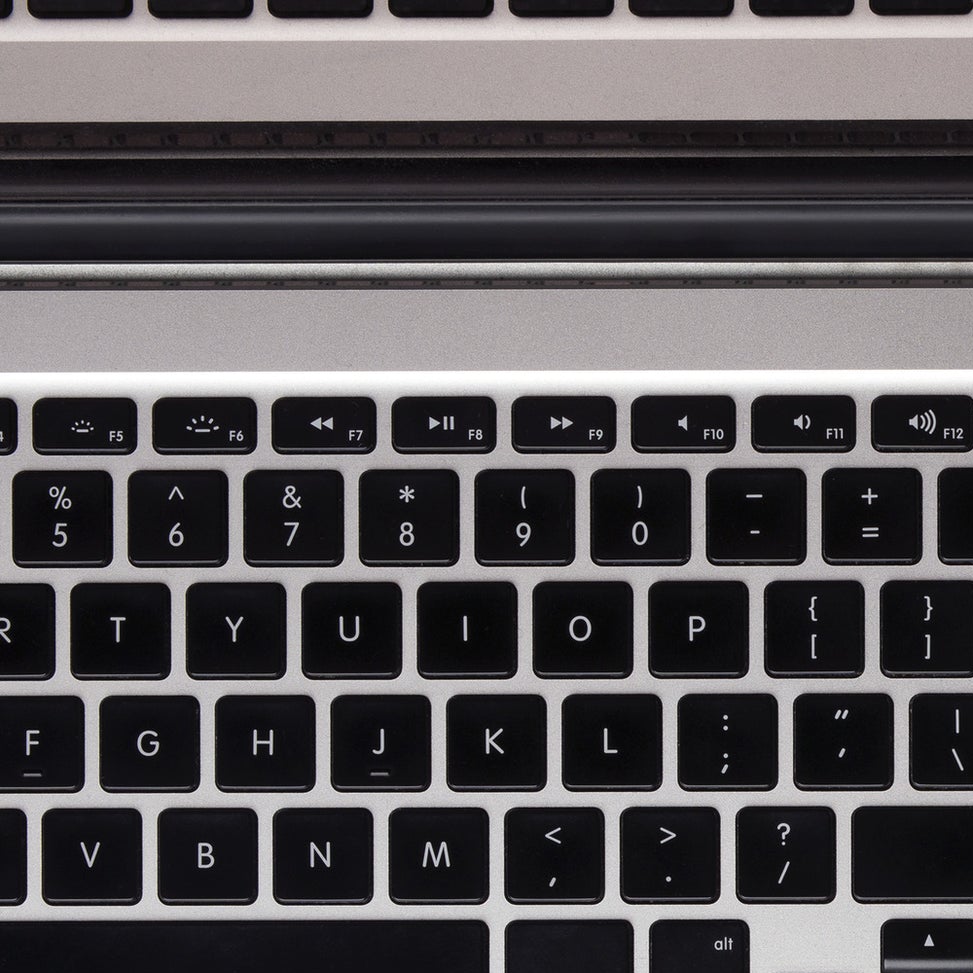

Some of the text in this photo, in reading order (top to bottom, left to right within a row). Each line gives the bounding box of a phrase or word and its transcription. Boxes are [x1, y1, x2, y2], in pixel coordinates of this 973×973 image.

[108, 430, 124, 442] F5
[228, 430, 244, 442] F6
[348, 429, 364, 442] F7
[468, 428, 484, 441] F8
[588, 428, 604, 441] F9
[703, 428, 724, 440] F10
[826, 428, 845, 440] F11
[943, 427, 964, 440] F12
[49, 486, 72, 510] %
[282, 485, 302, 509] &
[52, 523, 68, 548] 5
[168, 522, 184, 547] 6
[284, 522, 300, 547] 7
[399, 521, 415, 547] 8
[516, 522, 531, 547] 9
[110, 616, 126, 643] T
[225, 616, 244, 643] Y
[339, 615, 360, 642] U
[688, 615, 706, 642] P
[25, 729, 40, 756] F
[136, 730, 160, 757] G
[252, 729, 274, 756] H
[372, 728, 386, 755] J
[485, 728, 505, 755] K
[603, 727, 618, 754] L
[776, 822, 791, 846] ?
[80, 841, 101, 868] V
[197, 842, 215, 869] B
[310, 841, 331, 868] N
[422, 841, 451, 868] M
[714, 936, 734, 951] alt
